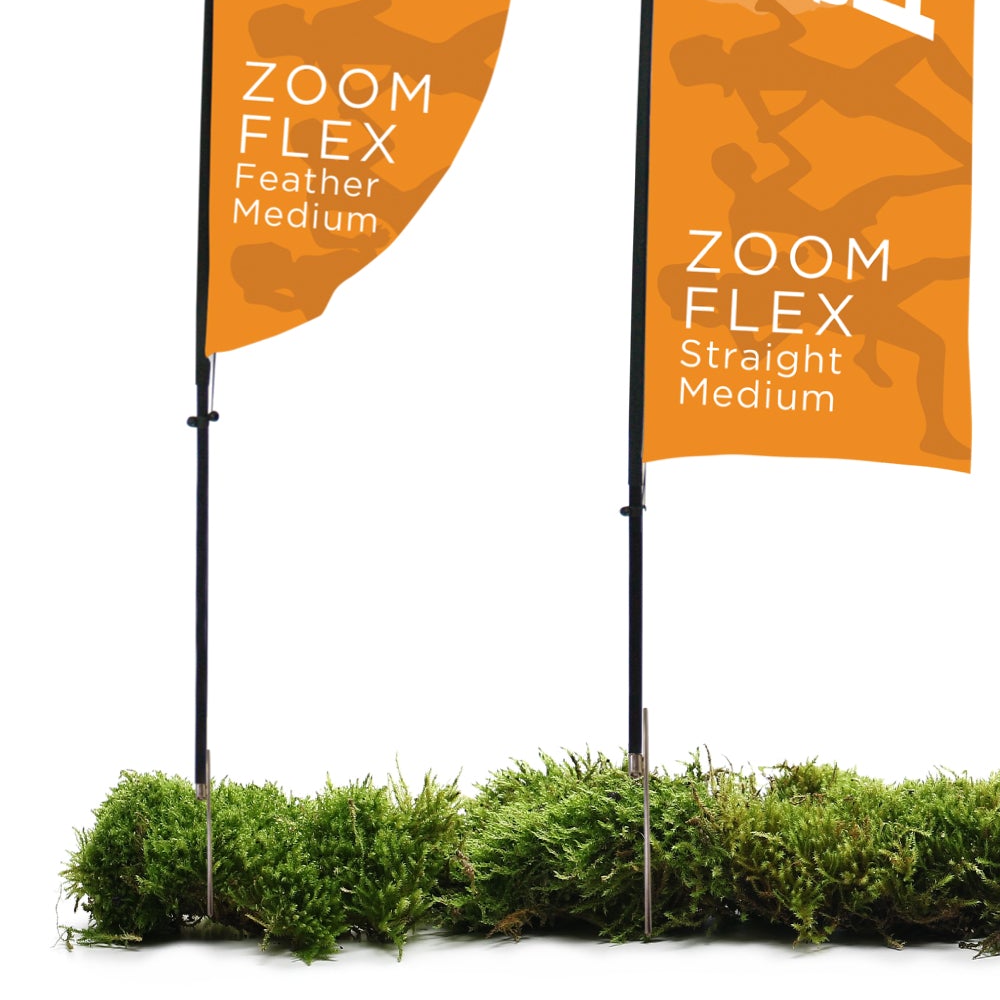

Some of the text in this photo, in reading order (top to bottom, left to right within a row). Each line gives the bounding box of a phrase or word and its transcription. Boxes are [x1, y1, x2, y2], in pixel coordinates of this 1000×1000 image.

[242, 60, 431, 114] ZOOM
[240, 113, 397, 164] FLEX
[235, 162, 380, 198] Feather
[233, 197, 378, 233] Medium
[686, 229, 890, 282] ZOOM
[685, 286, 855, 337] FLEX
[680, 338, 843, 378] Straight
[679, 376, 835, 412] Medium
